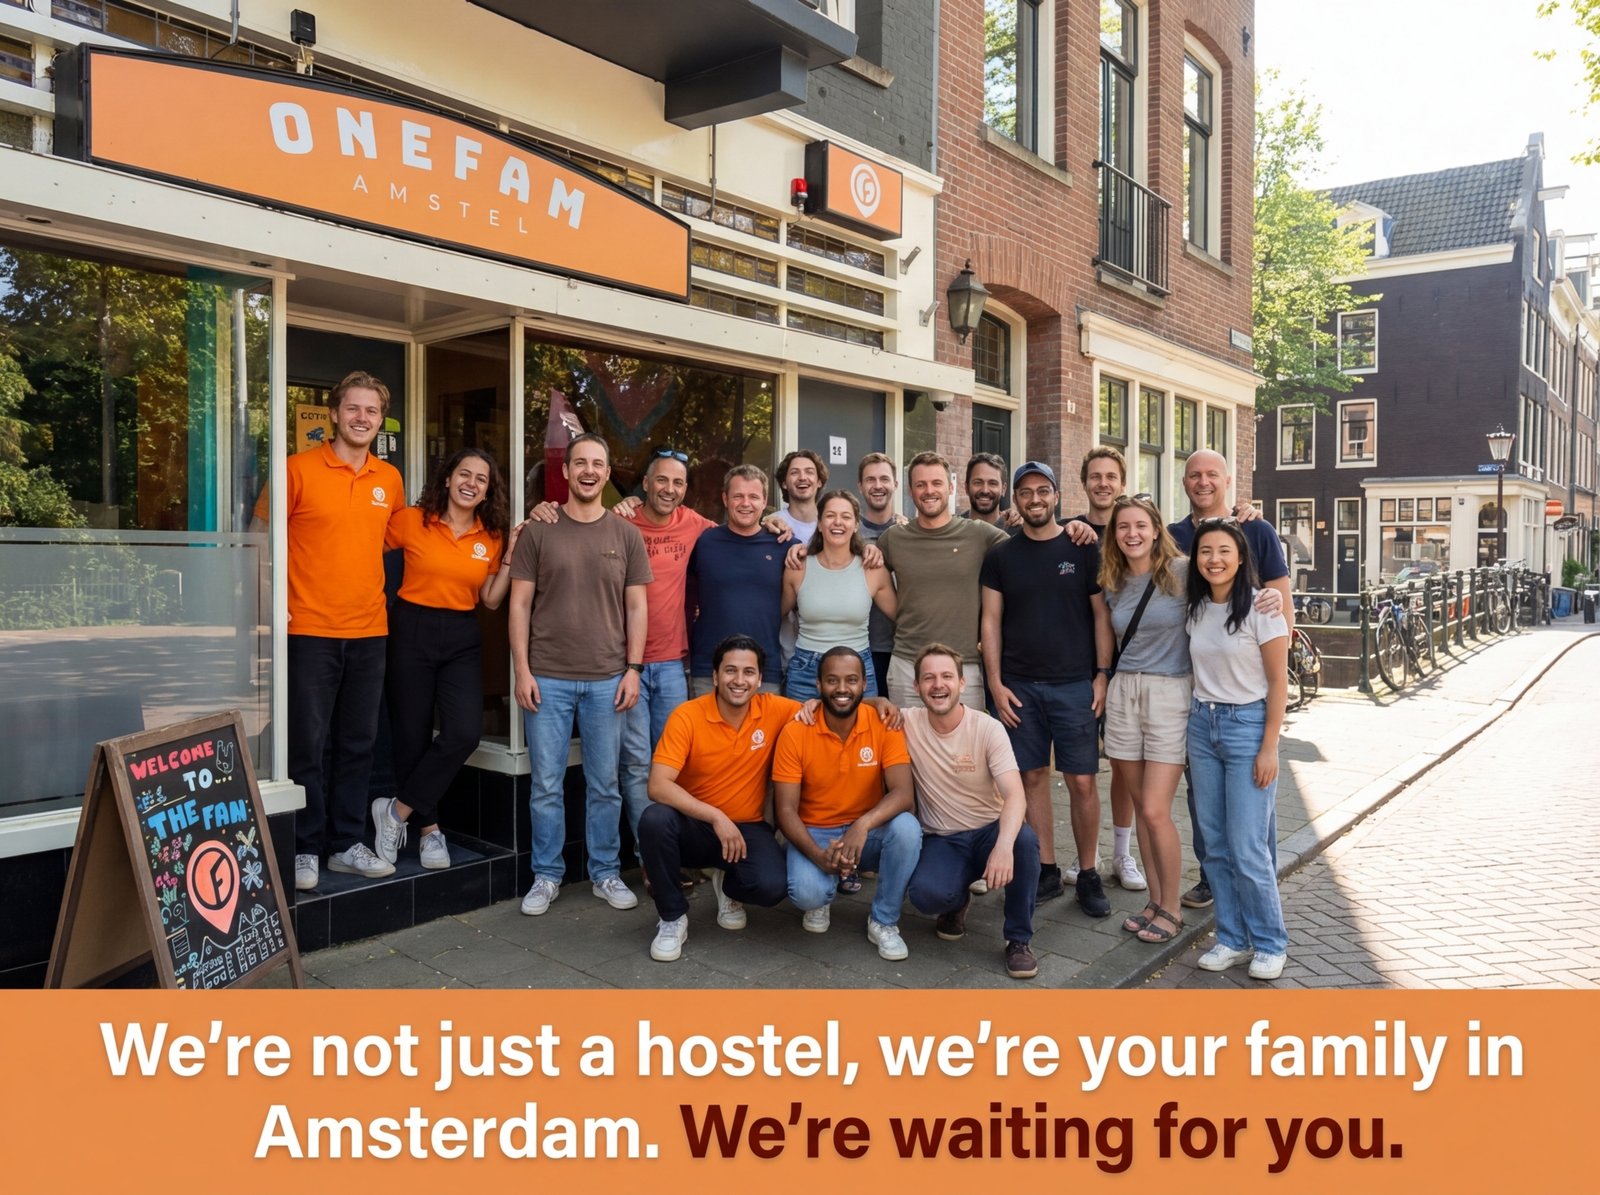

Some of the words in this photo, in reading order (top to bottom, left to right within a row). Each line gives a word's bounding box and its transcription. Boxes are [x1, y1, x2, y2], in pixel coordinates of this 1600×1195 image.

[269, 102, 585, 230] ONEFAM
[353, 174, 528, 234] AMSTEL
[130, 741, 214, 780] WELCOME
[147, 799, 200, 840] THE
[202, 799, 248, 831] FAN
